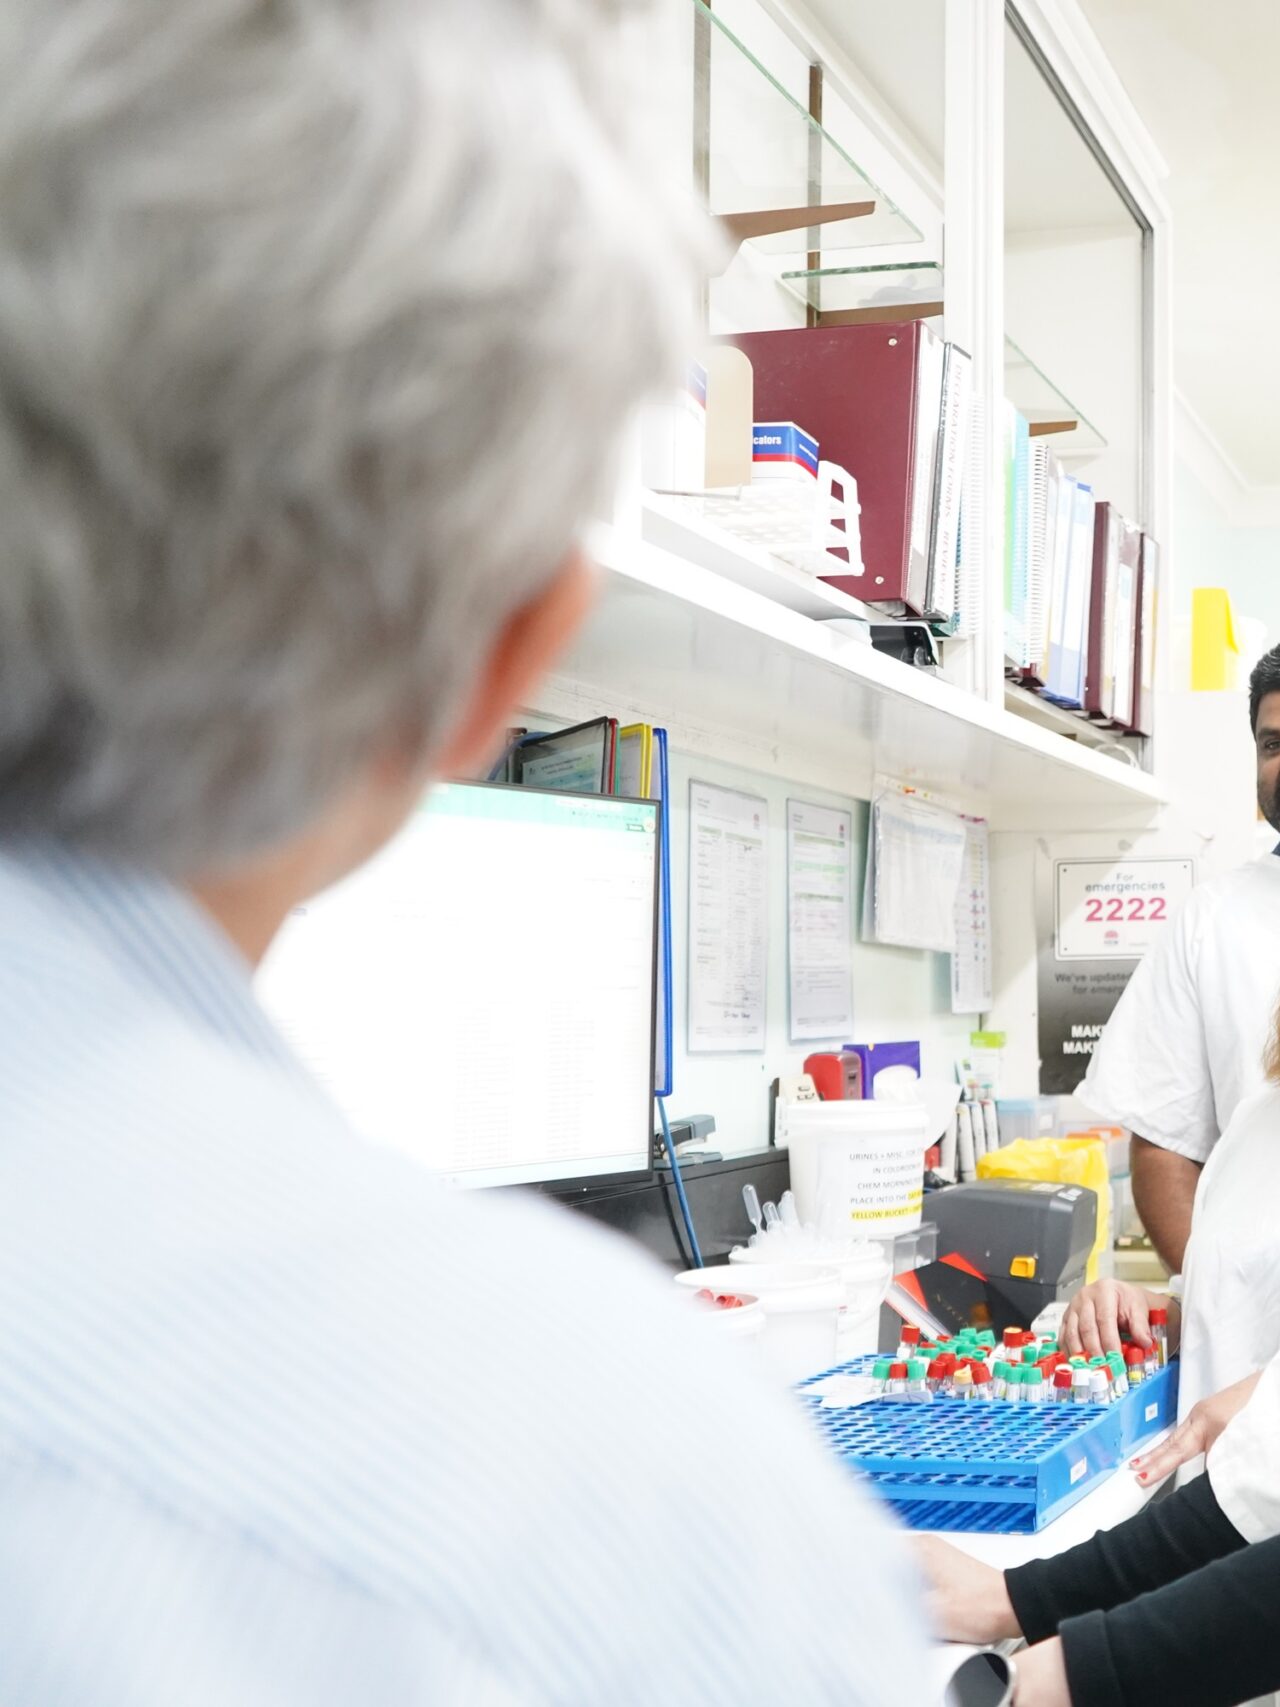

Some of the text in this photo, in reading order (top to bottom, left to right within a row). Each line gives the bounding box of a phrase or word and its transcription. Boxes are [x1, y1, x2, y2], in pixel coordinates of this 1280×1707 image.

[753, 435, 782, 445] cators
[1116, 873, 1134, 881] For
[1085, 881, 1166, 892] emergencies
[1085, 897, 1167, 922] 2222
[1055, 972, 1086, 983] We've
[1072, 985, 1087, 994] for
[1071, 1024, 1104, 1038] MAK
[1062, 1040, 1095, 1055] MAK
[849, 1153, 879, 1161] URINES
[857, 1182, 881, 1190] CHEM
[850, 1196, 874, 1205] PLACE
[876, 1194, 894, 1203] INTO
[852, 1210, 882, 1219] YELLOW
[885, 1207, 909, 1217] BUCKET
